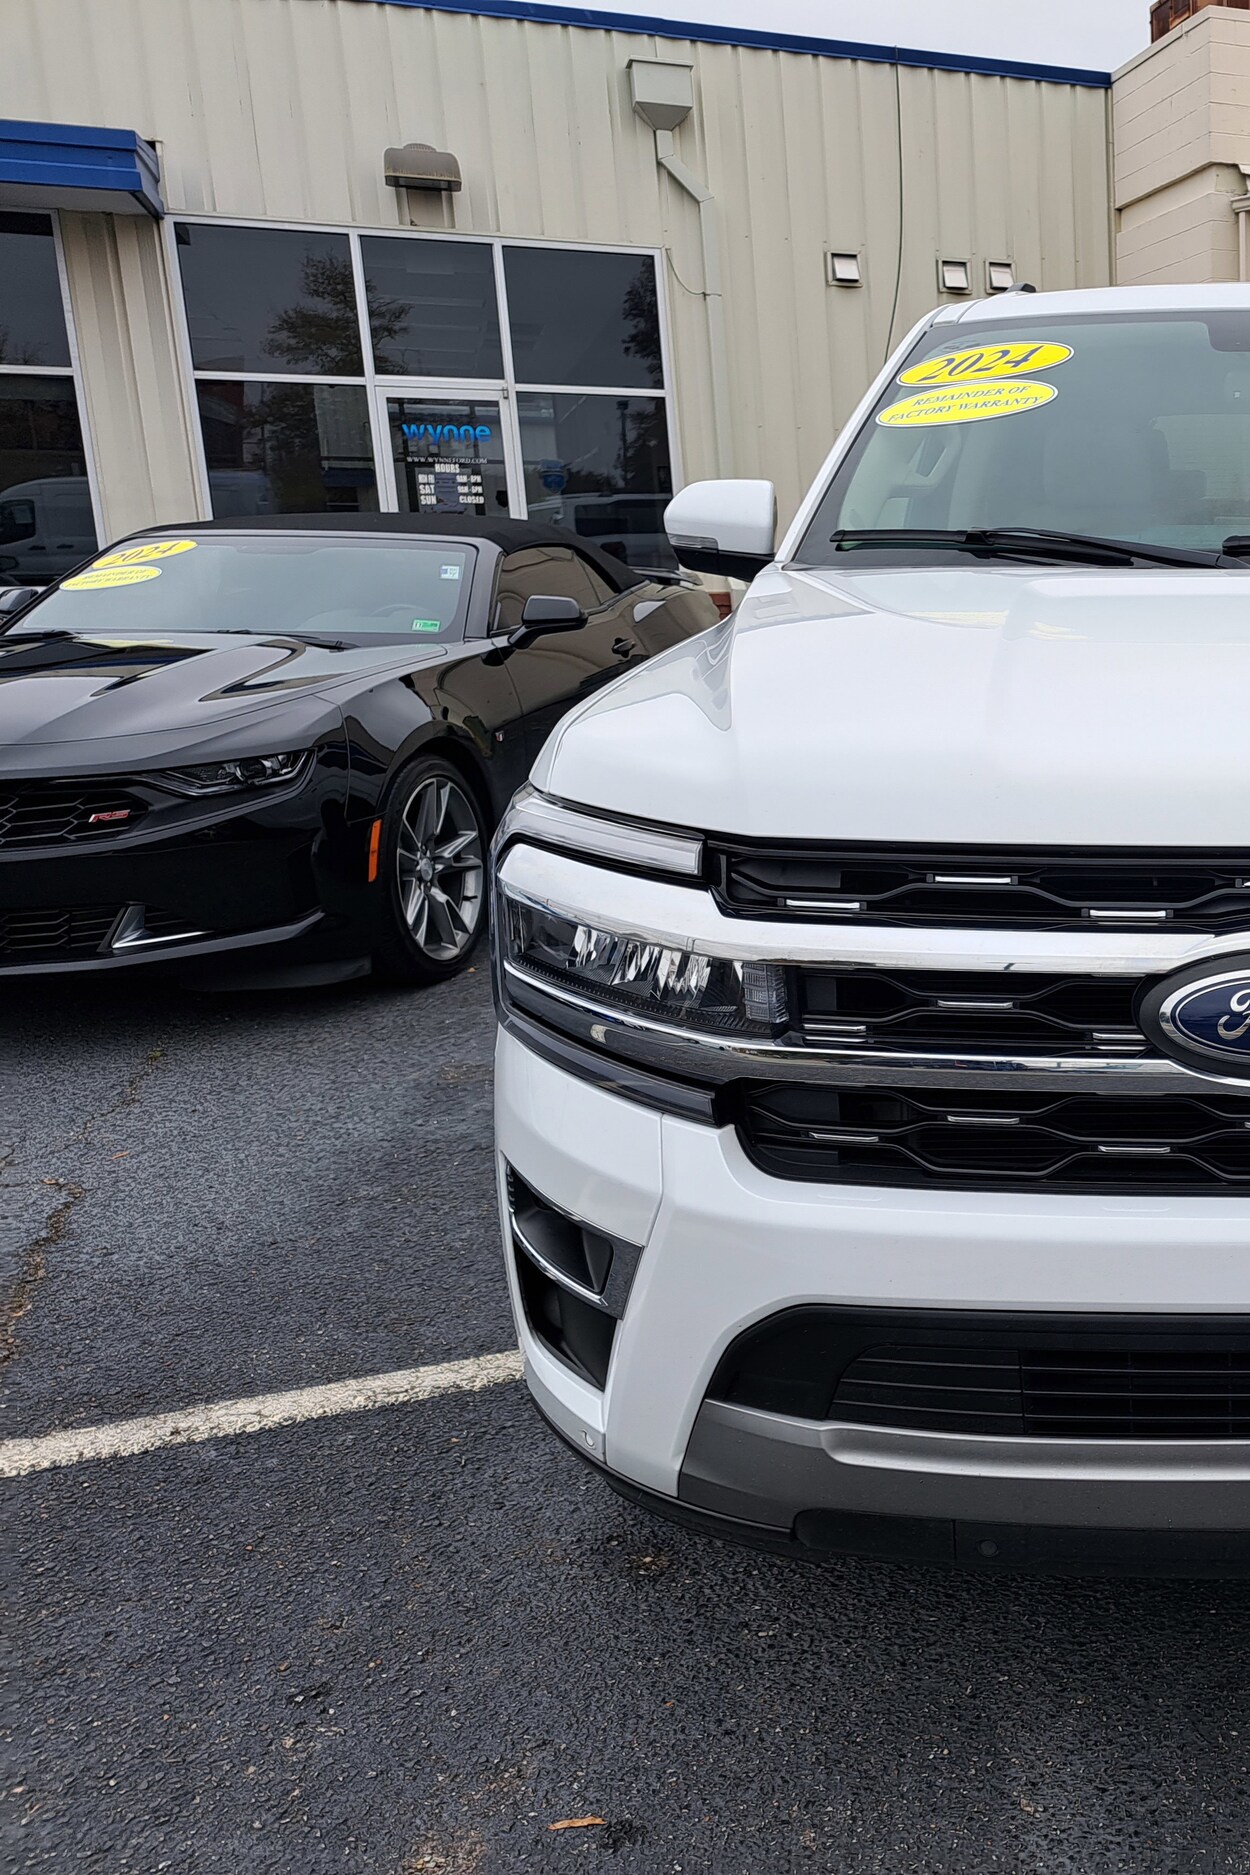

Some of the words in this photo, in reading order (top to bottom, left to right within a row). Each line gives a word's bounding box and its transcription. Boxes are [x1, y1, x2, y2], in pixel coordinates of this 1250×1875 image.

[916, 345, 1045, 382] 2024
[912, 387, 1006, 407] REMAINDER
[1007, 385, 1032, 395] OF
[887, 404, 957, 423] FACTORY
[958, 396, 1044, 411] WARRANTY
[401, 423, 492, 446] wynne
[434, 463, 460, 473] HOURS
[419, 484, 435, 494] SAT
[420, 494, 437, 505] SUN
[459, 495, 485, 504] CLOSED
[88, 809, 131, 823] RS
